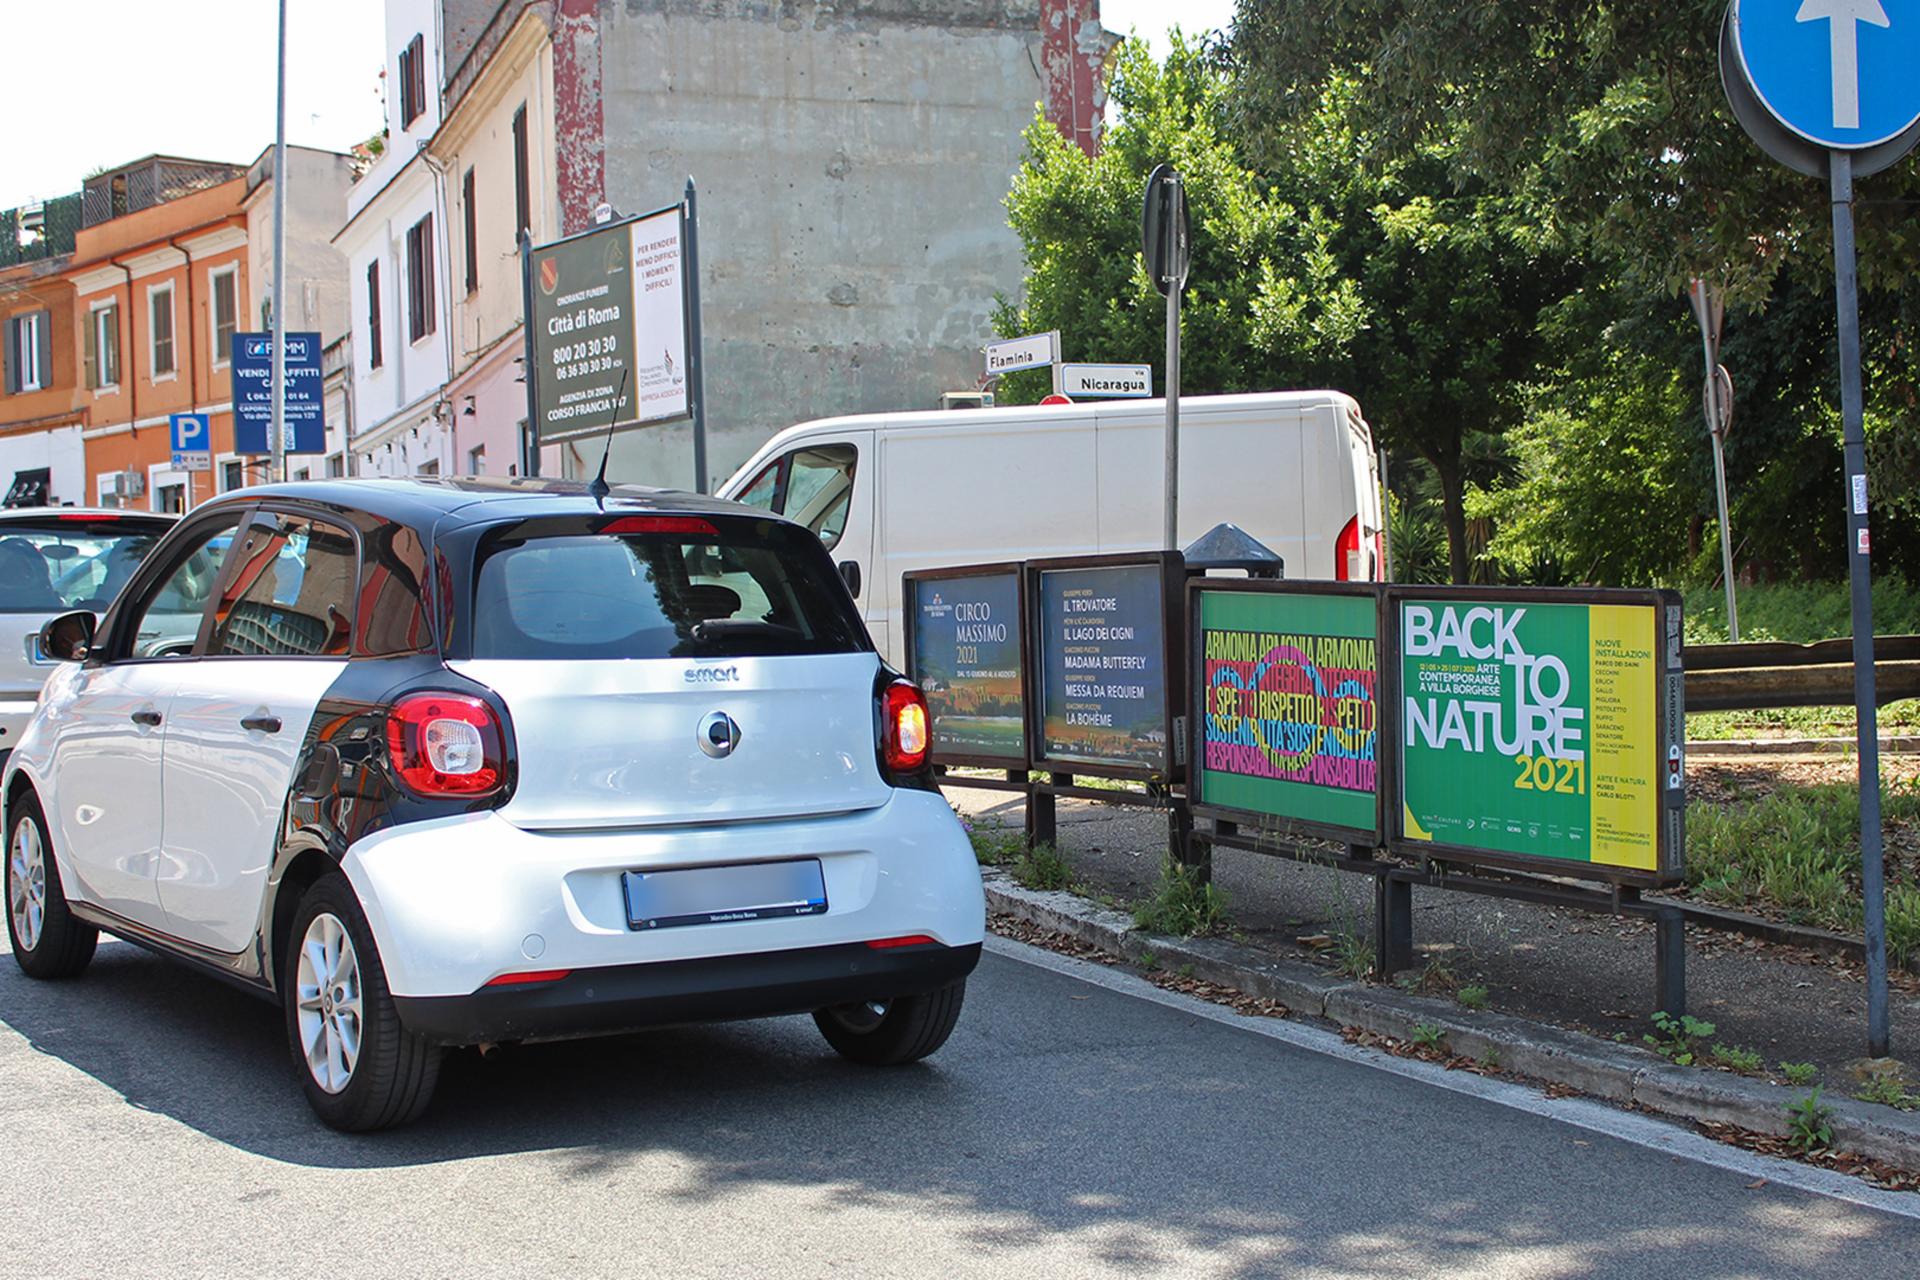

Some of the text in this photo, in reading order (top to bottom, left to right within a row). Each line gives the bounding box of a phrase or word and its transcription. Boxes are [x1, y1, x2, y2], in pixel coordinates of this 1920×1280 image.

[646, 264, 675, 278] MOMENTI
[548, 305, 620, 336] Città di Roma
[553, 335, 616, 365] 800 20 30 30
[990, 351, 1033, 368] Flaminia
[237, 368, 270, 378] VENDI
[556, 367, 567, 381] 06
[568, 364, 578, 379] 36
[578, 361, 589, 376] 30
[590, 359, 600, 373] 30
[601, 356, 612, 371] 30
[262, 378, 296, 387] CA?
[1081, 378, 1145, 392] Nicaragua
[559, 391, 586, 404] AGENZIA
[595, 385, 614, 397] ZONA
[547, 406, 574, 422] CORSO
[575, 399, 610, 416] FRANCIA
[177, 417, 202, 448] P
[955, 602, 991, 622] CIRCO
[1063, 598, 1117, 612] IL TROVATORE
[956, 623, 1007, 642] MASSIMO
[1063, 627, 1134, 640] IL LAGO DEI CIGNI
[1405, 605, 1527, 660] BACK
[1206, 631, 1377, 671] ARMONIA ARMONIA ARMONIA
[1595, 639, 1621, 648] NUOVE
[956, 645, 978, 664] 2021
[1064, 656, 1146, 669] MADAMA BUTTERFLY
[1595, 649, 1651, 659] INSTALLAZIONI
[684, 665, 740, 683] smart
[1477, 664, 1500, 674] ARTE
[1418, 671, 1500, 685] CONTEMPORANEA
[1505, 653, 1571, 708] TO
[1065, 684, 1145, 699] MESSA DA REQUIEM
[1419, 682, 1501, 697] A VILLA BORGHESE
[1066, 710, 1112, 727] LA BOHÈME
[1259, 691, 1315, 724] RISPETTO
[1316, 695, 1377, 731] RISPETTO
[1406, 697, 1585, 762] NATURE
[1514, 754, 1586, 795] 2021
[1597, 791, 1613, 799] CARLO
